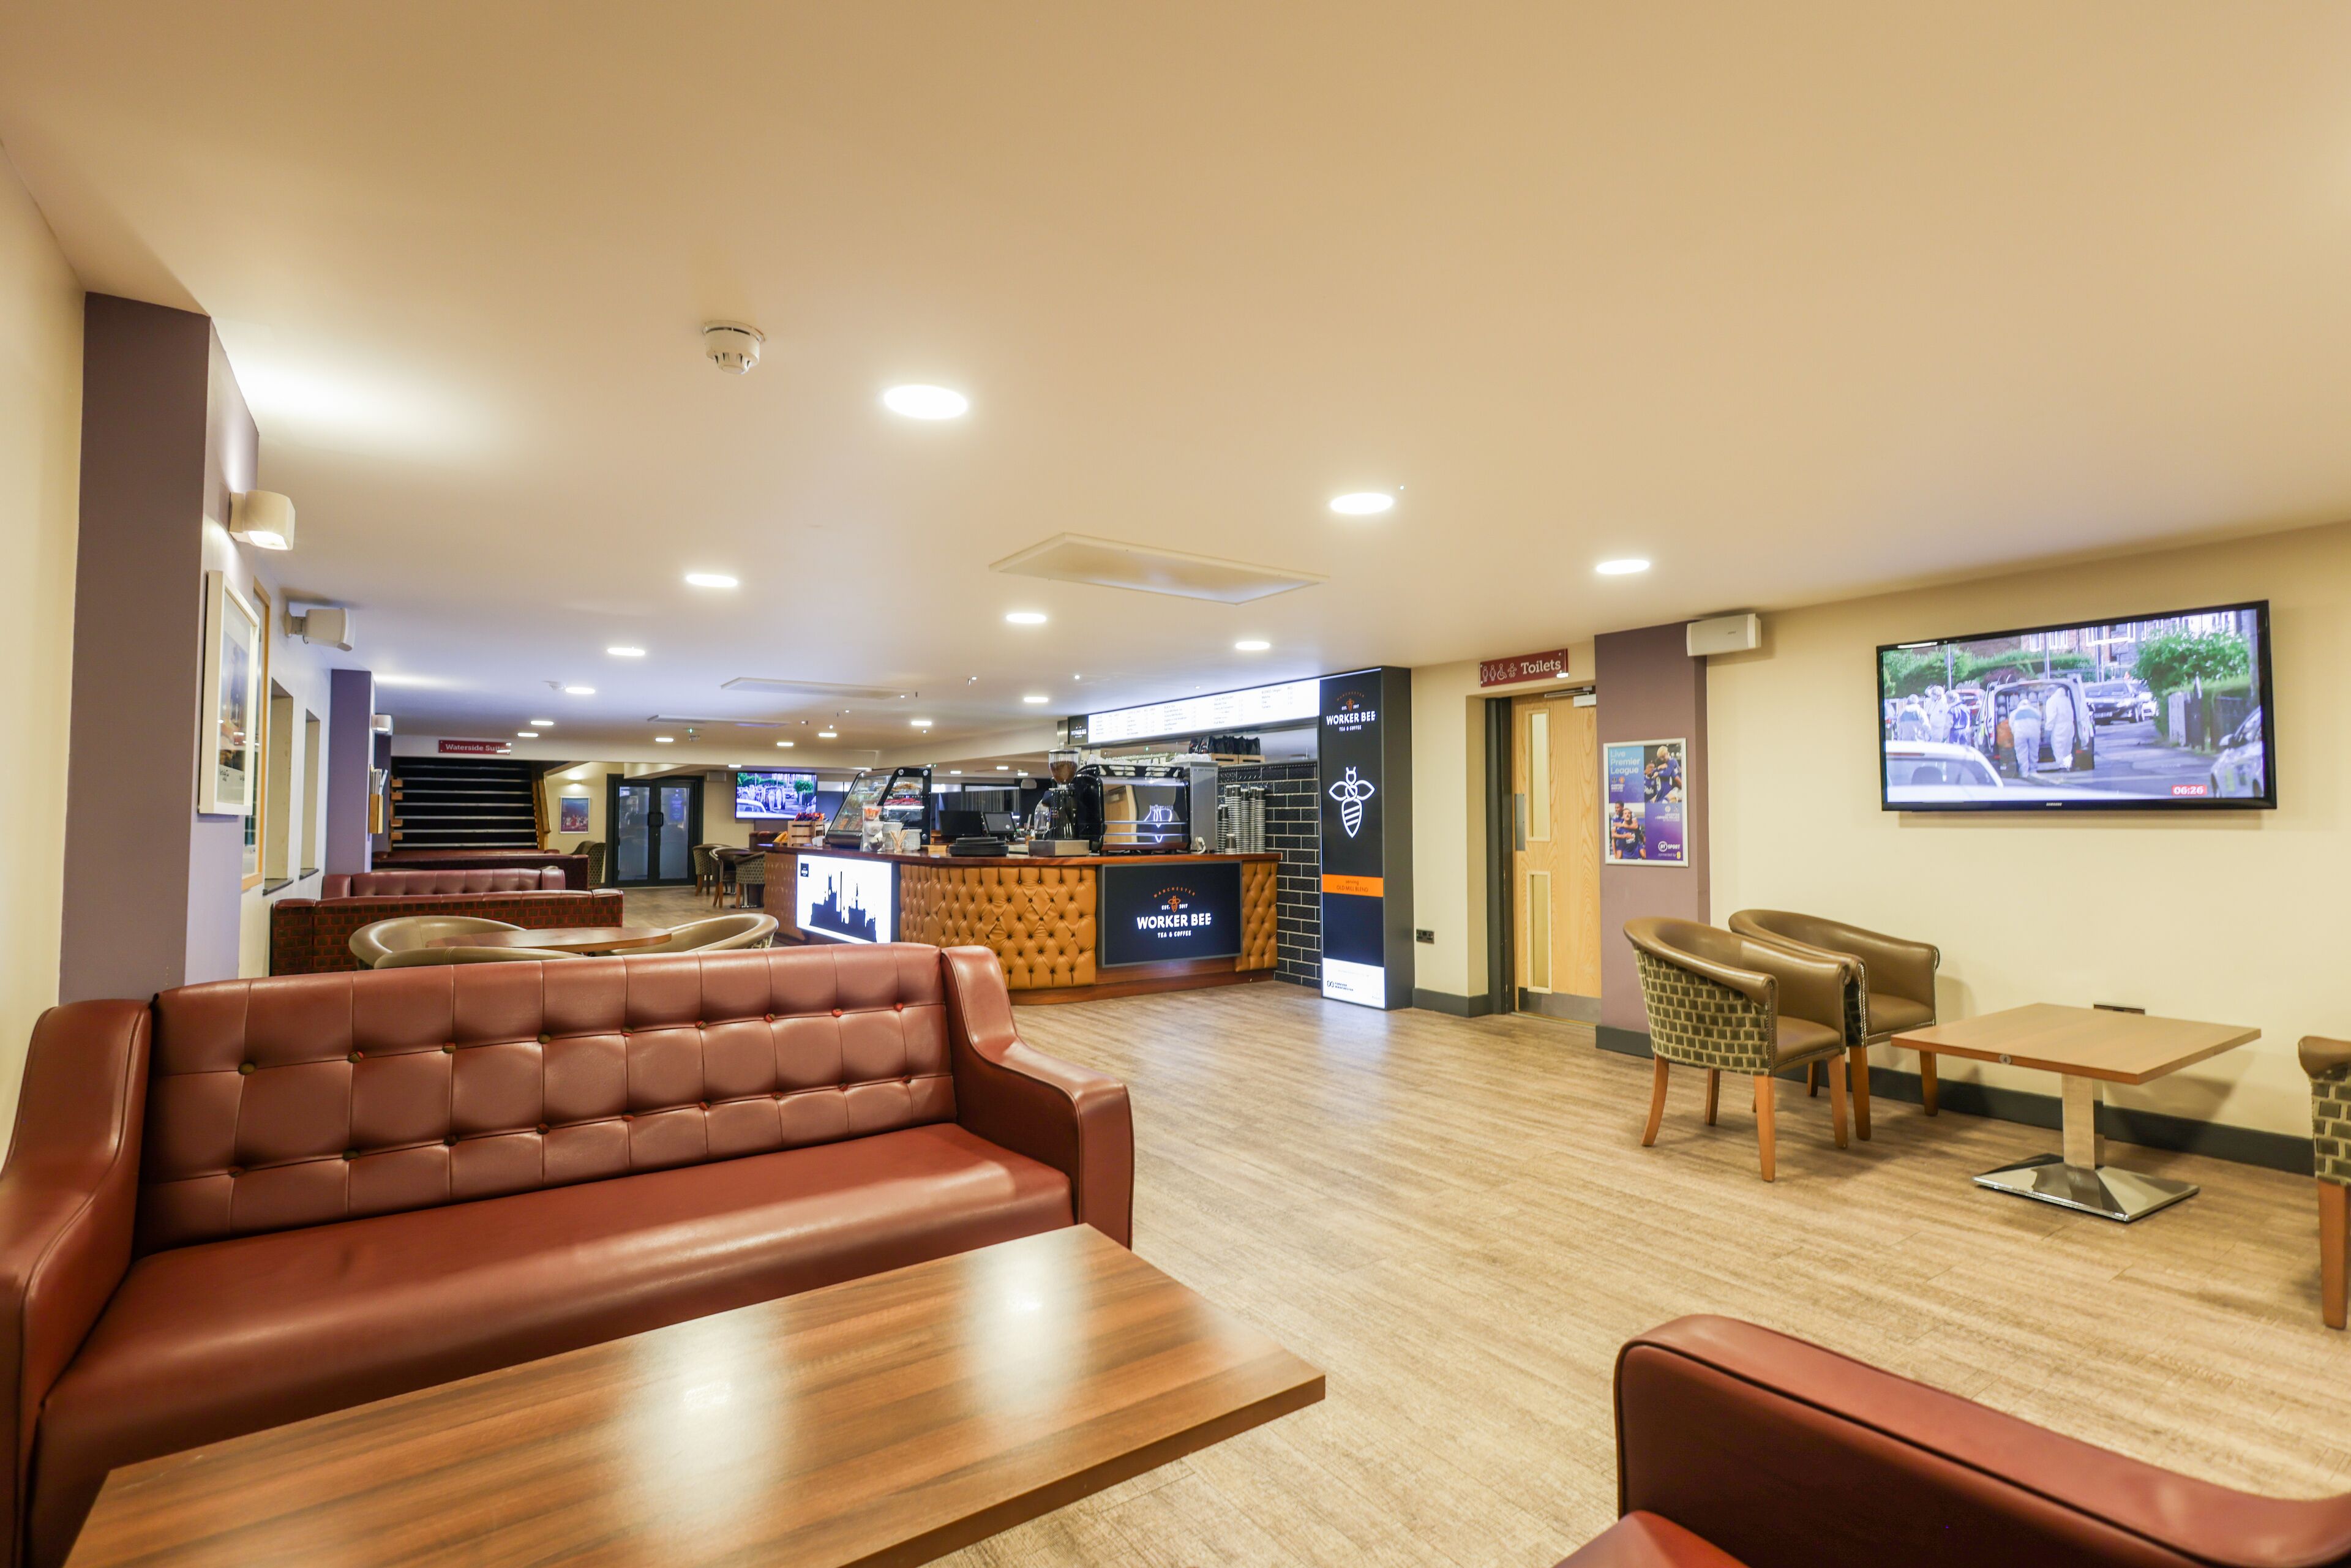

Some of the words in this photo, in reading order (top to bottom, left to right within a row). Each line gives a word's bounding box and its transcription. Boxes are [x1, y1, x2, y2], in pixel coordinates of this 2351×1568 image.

[1521, 659, 1561, 675] Toilets
[1326, 712, 1359, 726] WORKER
[1361, 711, 1376, 722] BEE
[1611, 757, 1641, 766] Premier
[1611, 767, 1639, 776] League
[2174, 786, 2204, 795] 06:26
[1153, 887, 1195, 898] MANCHESTER
[1137, 914, 1188, 929] WORKER
[1191, 913, 1212, 926] BEE
